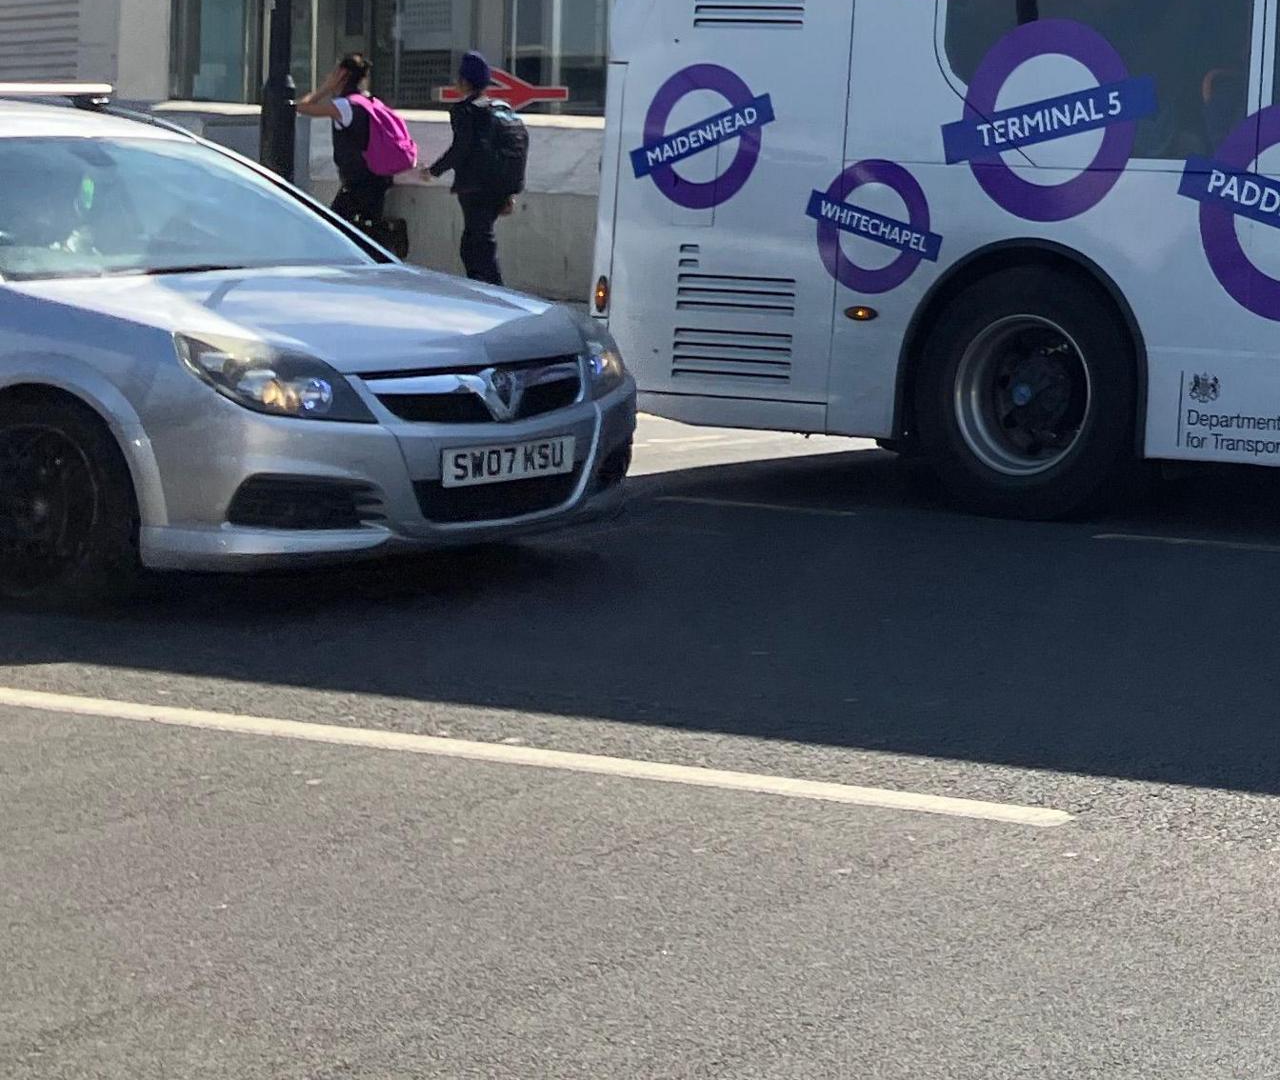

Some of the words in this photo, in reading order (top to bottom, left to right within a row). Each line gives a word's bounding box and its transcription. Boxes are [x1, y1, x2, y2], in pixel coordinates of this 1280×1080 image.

[646, 106, 758, 169] MAIDENHEAD
[977, 97, 1102, 146] TERMINAL
[1108, 92, 1121, 115] 5
[820, 200, 926, 252] WHITECHAPEL
[454, 448, 516, 480] SW07
[524, 441, 563, 471] KSU
[1186, 432, 1207, 448] for
